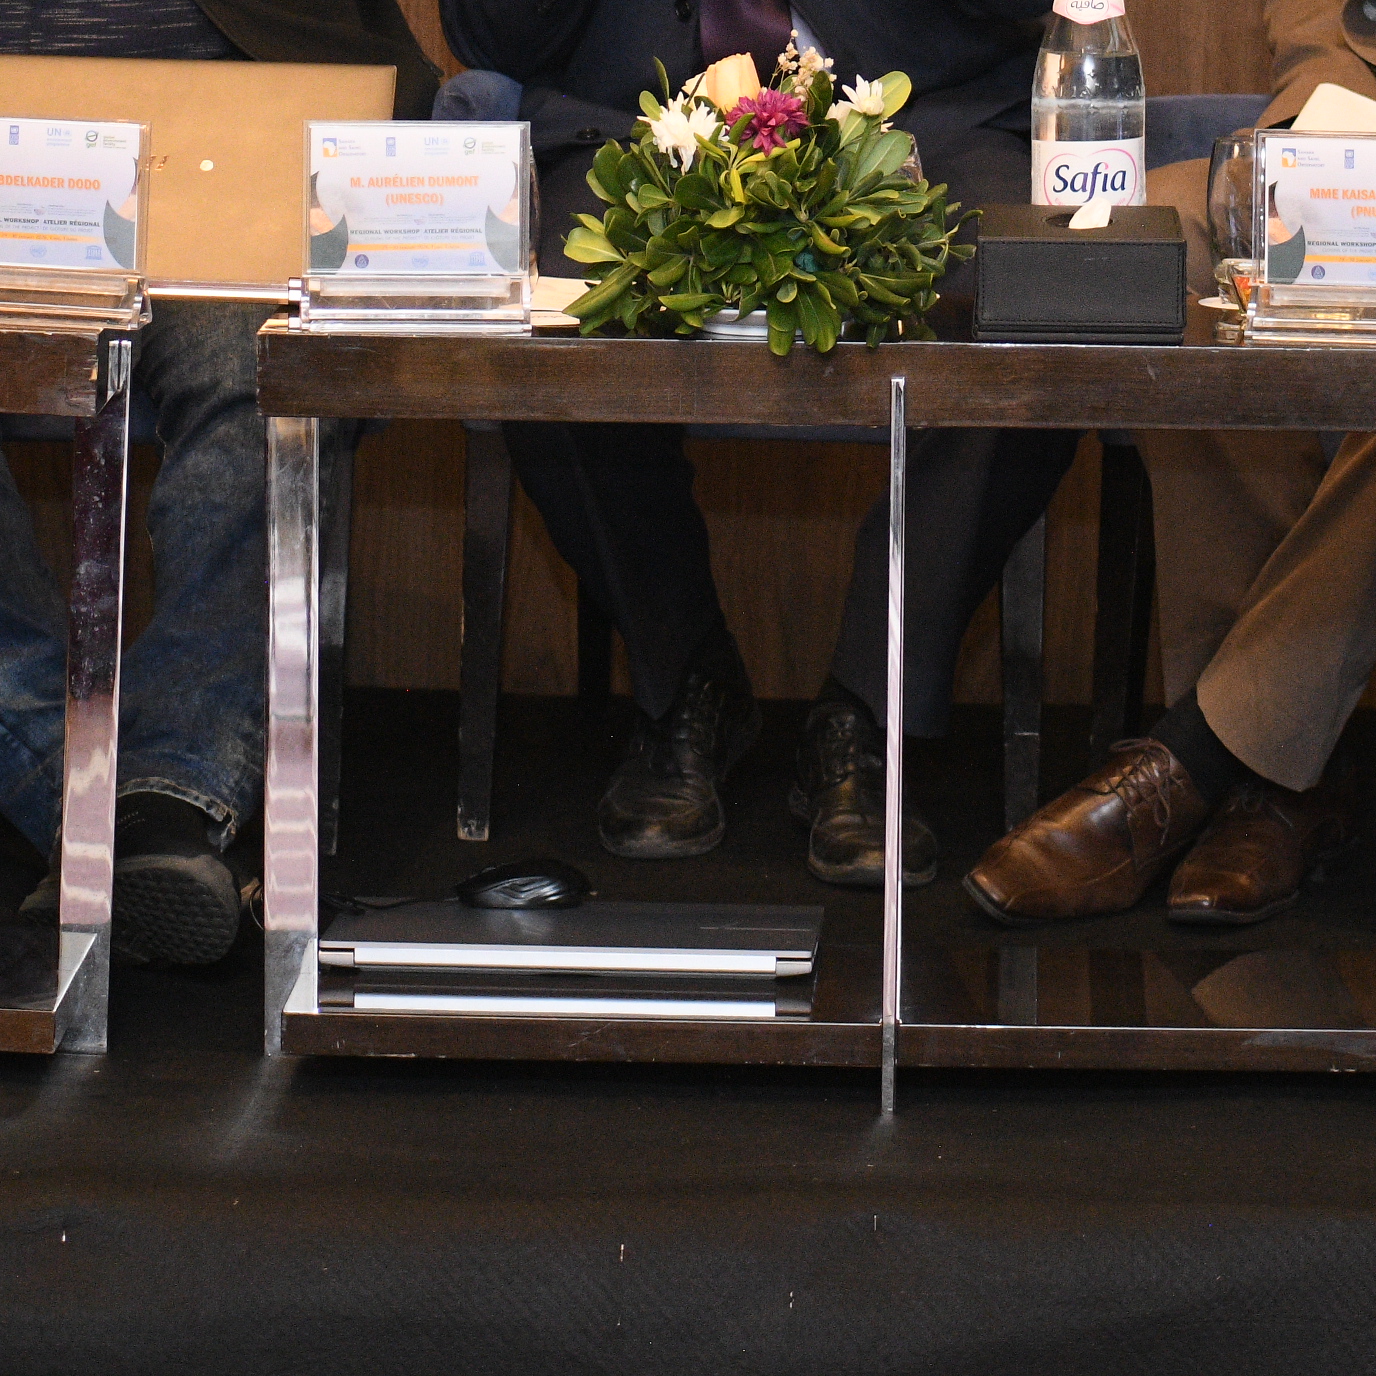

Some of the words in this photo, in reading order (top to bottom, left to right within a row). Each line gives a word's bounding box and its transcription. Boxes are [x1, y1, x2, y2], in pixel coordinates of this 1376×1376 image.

[47, 128, 62, 136] UN
[424, 137, 439, 145] UN
[68, 178, 101, 190] DODO
[350, 177, 364, 188] M.
[368, 174, 425, 188] AURÉLIEN
[428, 175, 479, 187] DUMONT
[1052, 162, 1126, 203] Safia
[386, 193, 444, 207] (UNESCO)
[1310, 188, 1339, 199] MME
[1342, 189, 1376, 200] KAISA
